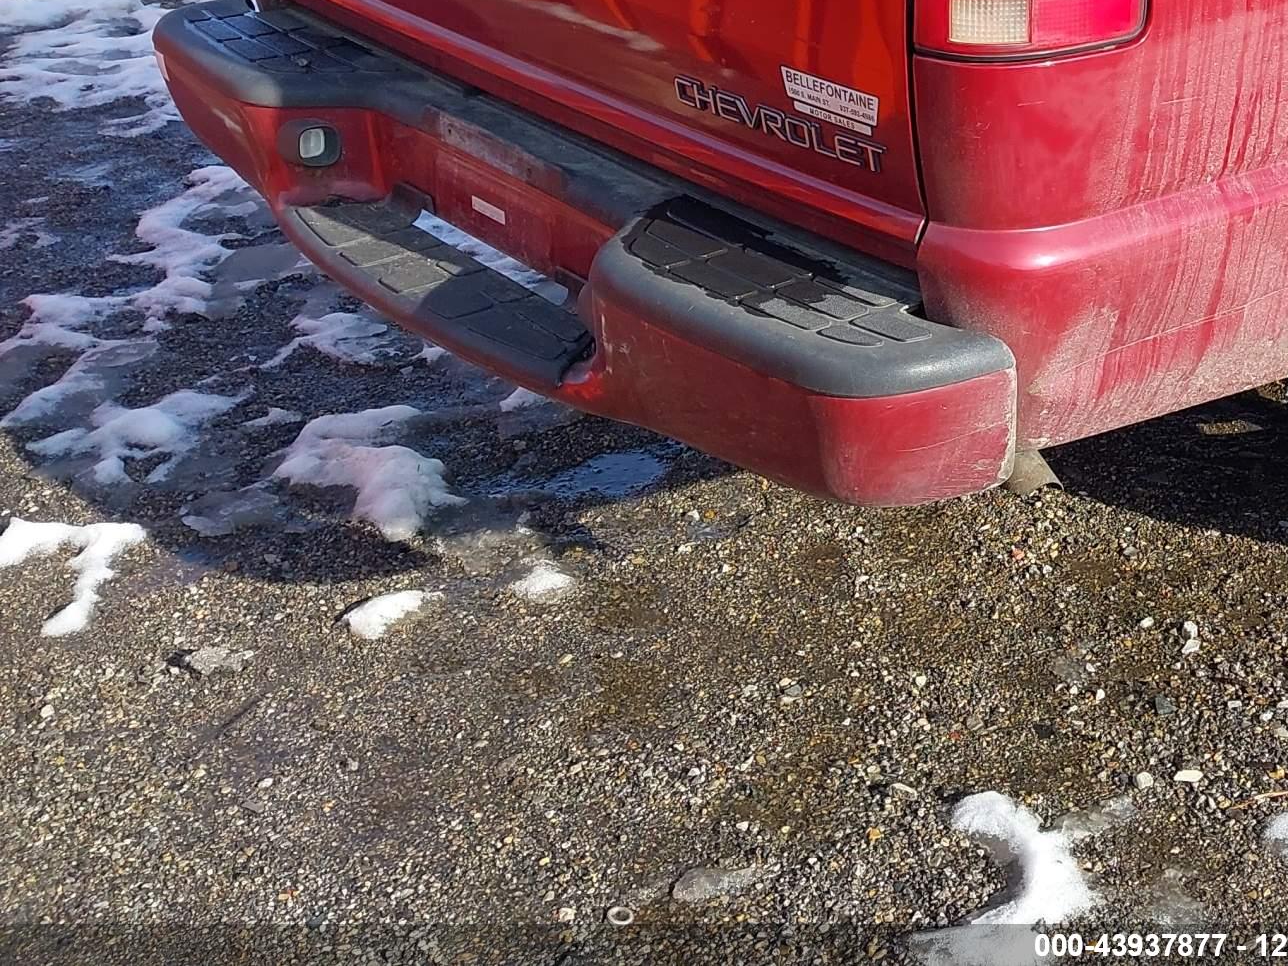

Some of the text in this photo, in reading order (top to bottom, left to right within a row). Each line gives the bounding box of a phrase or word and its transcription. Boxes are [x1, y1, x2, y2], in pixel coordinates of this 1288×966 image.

[785, 70, 875, 111] BELLEFONTAINE
[674, 74, 887, 173] CHEVROLET
[809, 107, 856, 130] MOTOR SALES
